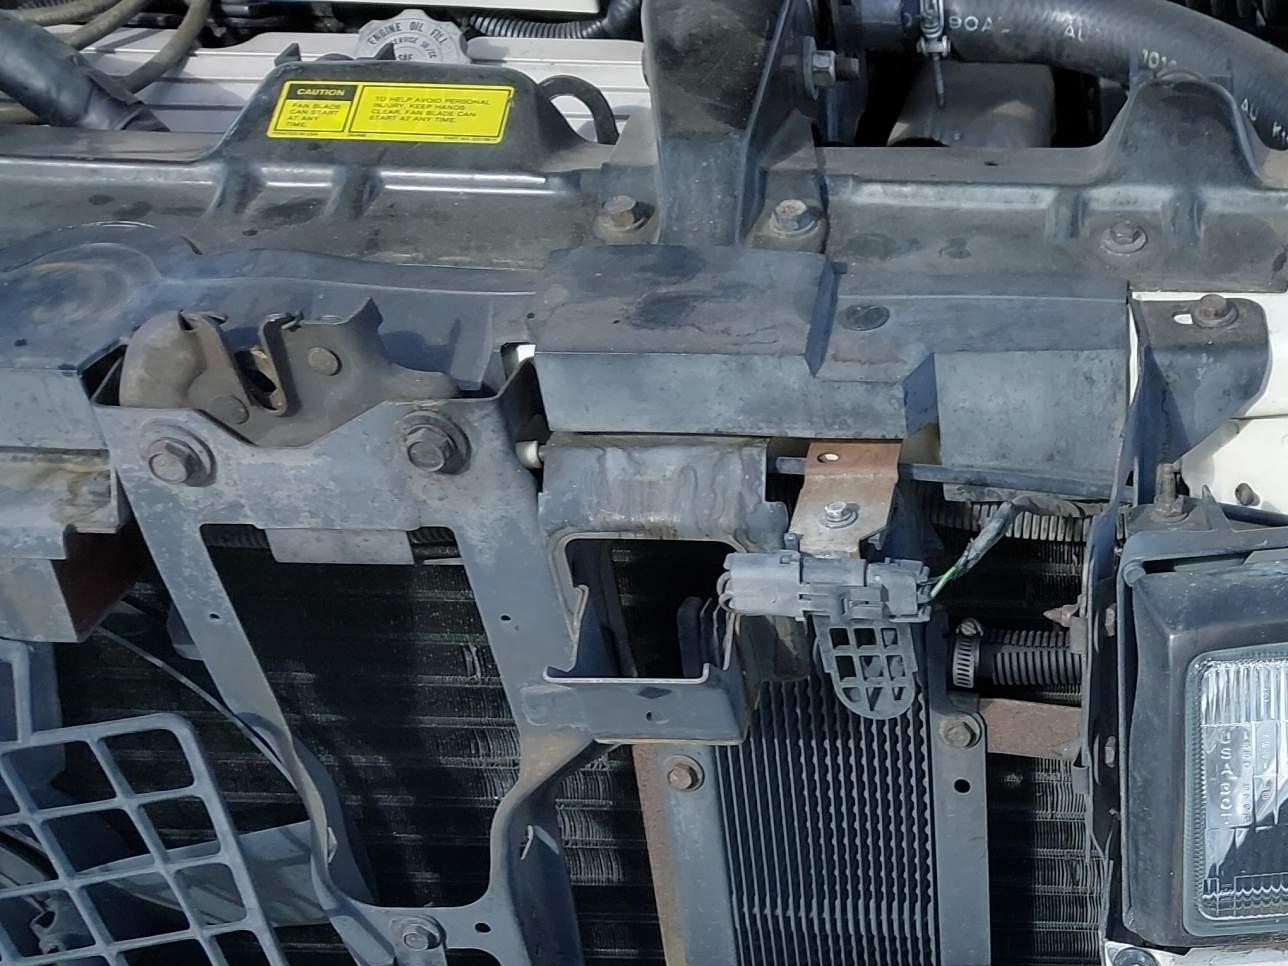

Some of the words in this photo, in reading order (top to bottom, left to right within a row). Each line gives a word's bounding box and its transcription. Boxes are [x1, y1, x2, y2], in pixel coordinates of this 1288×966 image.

[368, 22, 402, 45] ENGINE
[410, 21, 424, 32] OIL
[430, 28, 448, 44] FILL
[296, 88, 345, 96] CAUTION
